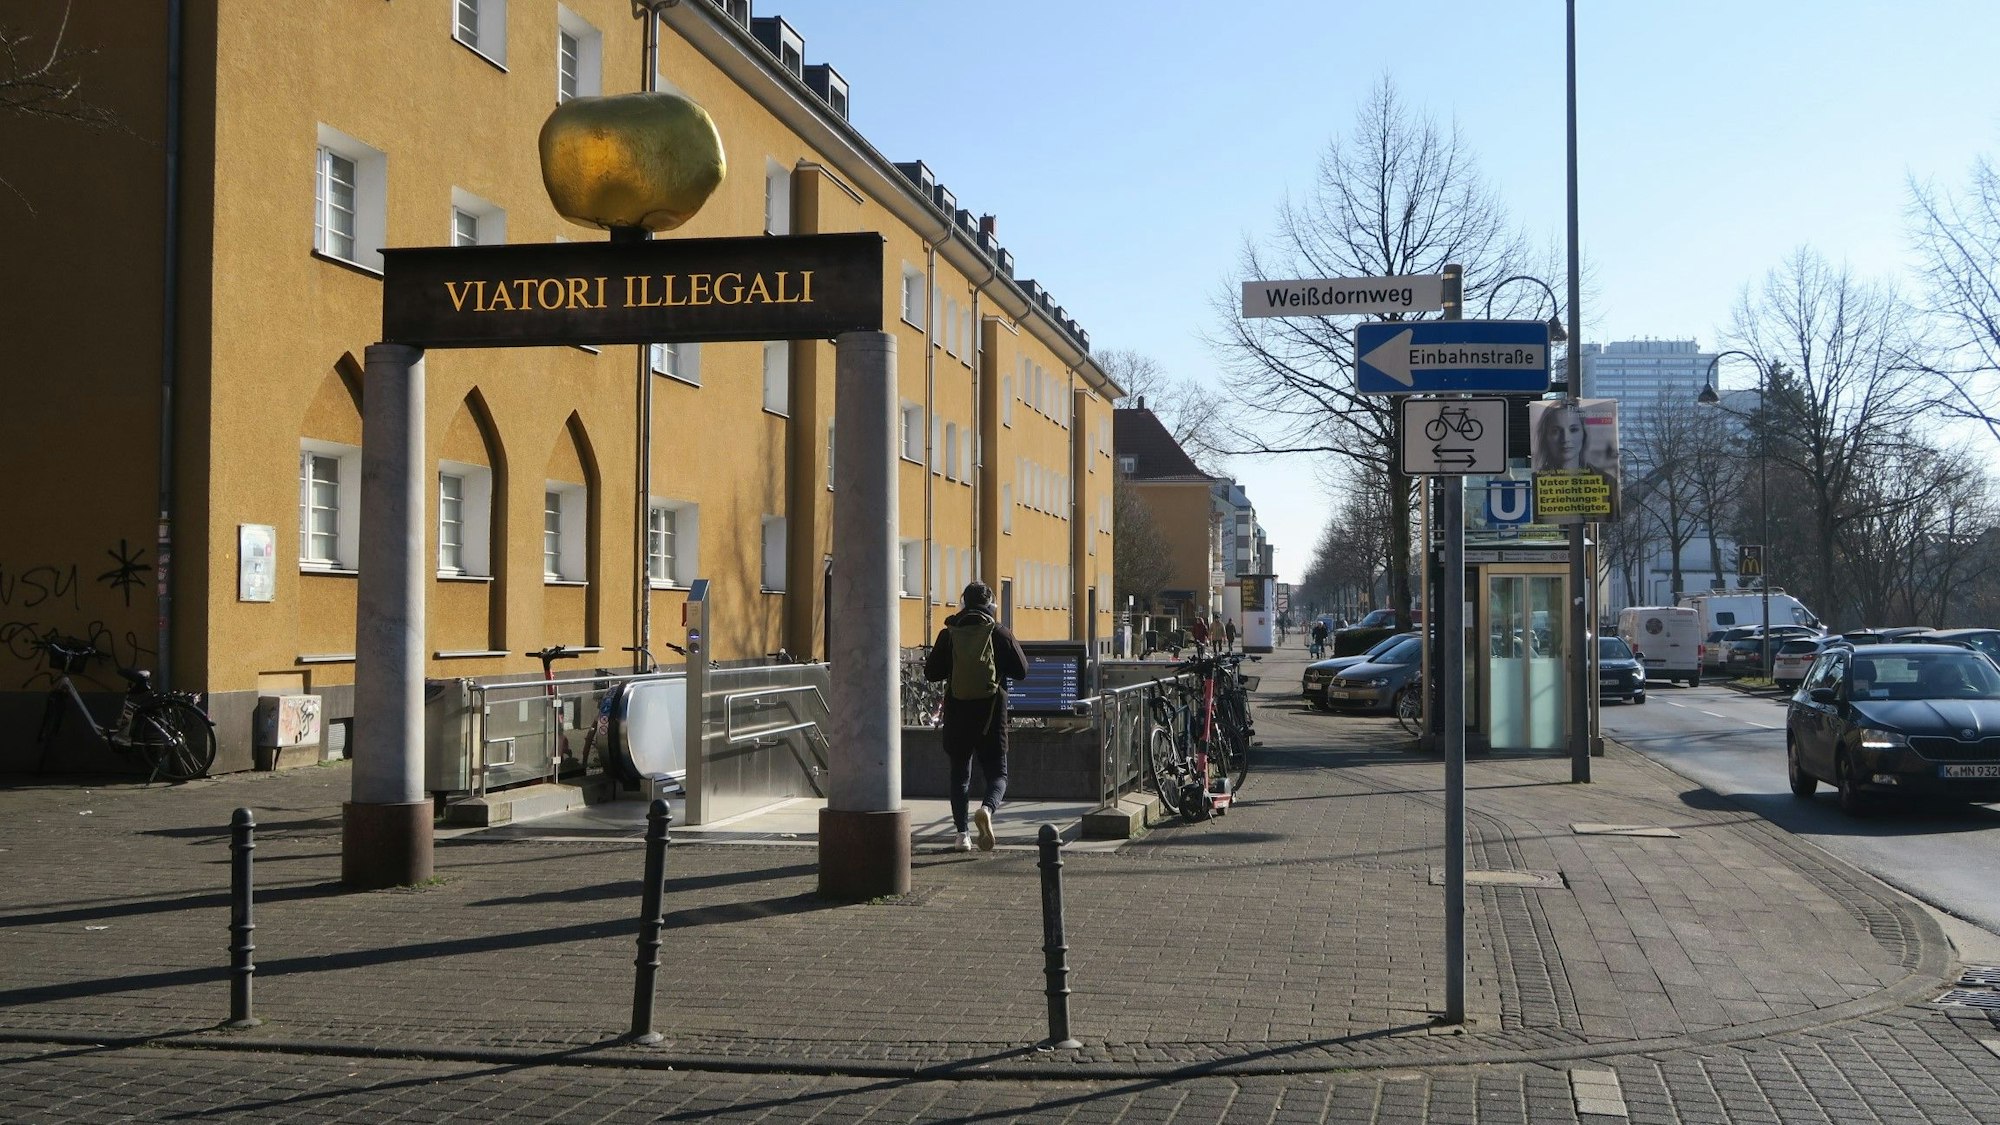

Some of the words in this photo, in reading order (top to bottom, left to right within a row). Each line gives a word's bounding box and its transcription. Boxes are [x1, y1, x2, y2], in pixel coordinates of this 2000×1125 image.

[444, 277, 608, 312] VIATORI
[623, 270, 814, 307] ILLEGALI
[1266, 286, 1413, 308] Weißdornweg
[1409, 349, 1534, 366] Einbahnstraße
[1539, 478, 1570, 486] Vater
[1571, 477, 1600, 485] Staat
[1555, 486, 1584, 494] nicht
[1585, 485, 1607, 493] Dein
[1491, 483, 1526, 520] U
[1540, 495, 1601, 504] Erziehungs-
[1540, 504, 1608, 513] berechtigter.
[1945, 766, 1953, 776] K
[1960, 766, 1975, 776] MN
